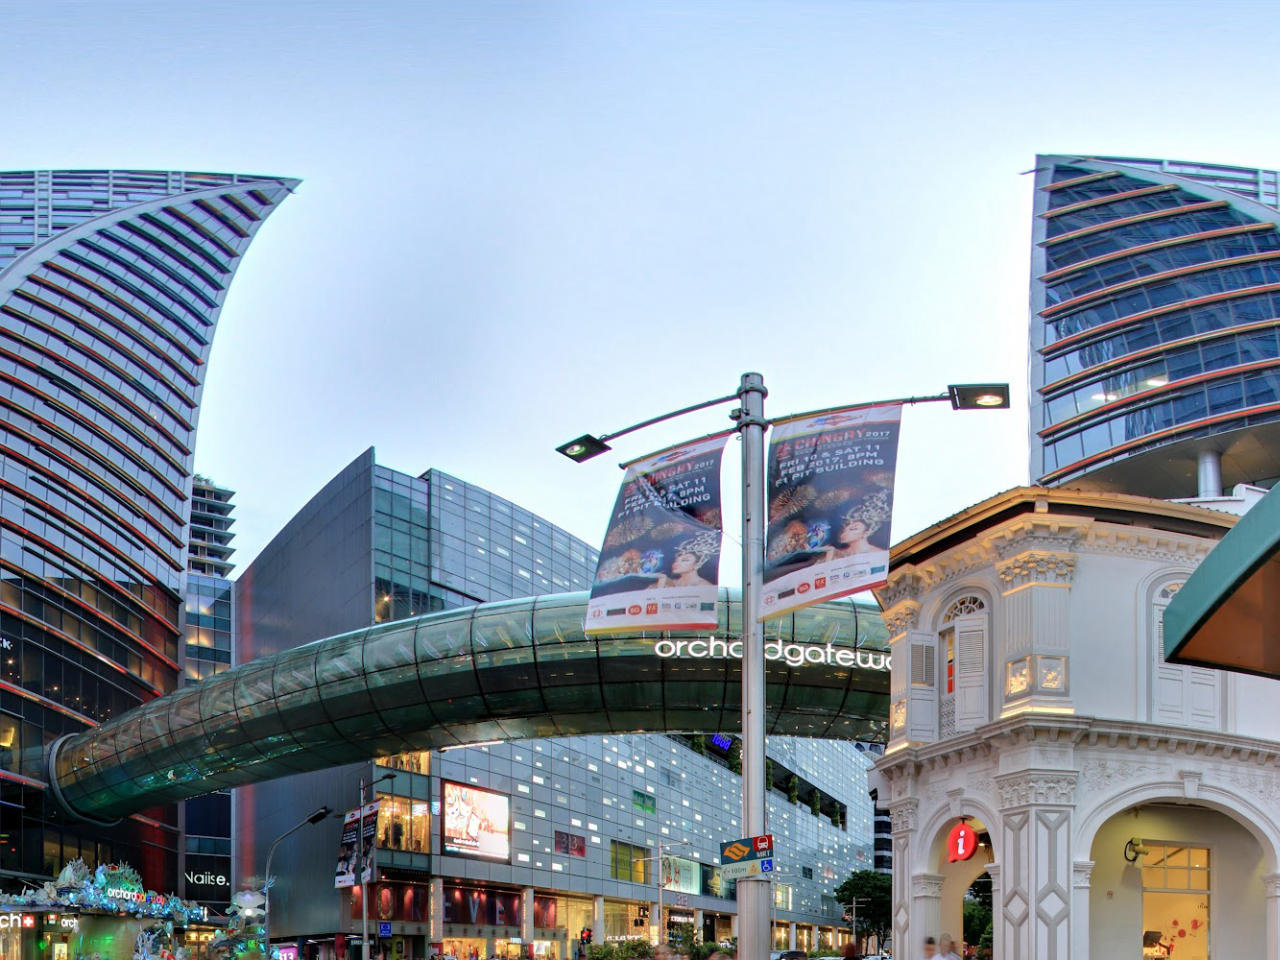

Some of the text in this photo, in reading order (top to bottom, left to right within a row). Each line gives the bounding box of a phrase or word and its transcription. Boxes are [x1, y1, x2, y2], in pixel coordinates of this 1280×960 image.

[779, 458, 799, 470] FRI
[835, 446, 861, 456] SAT
[791, 469, 813, 481] PIT
[815, 458, 885, 473] BUILDING
[780, 464, 805, 477] FEB
